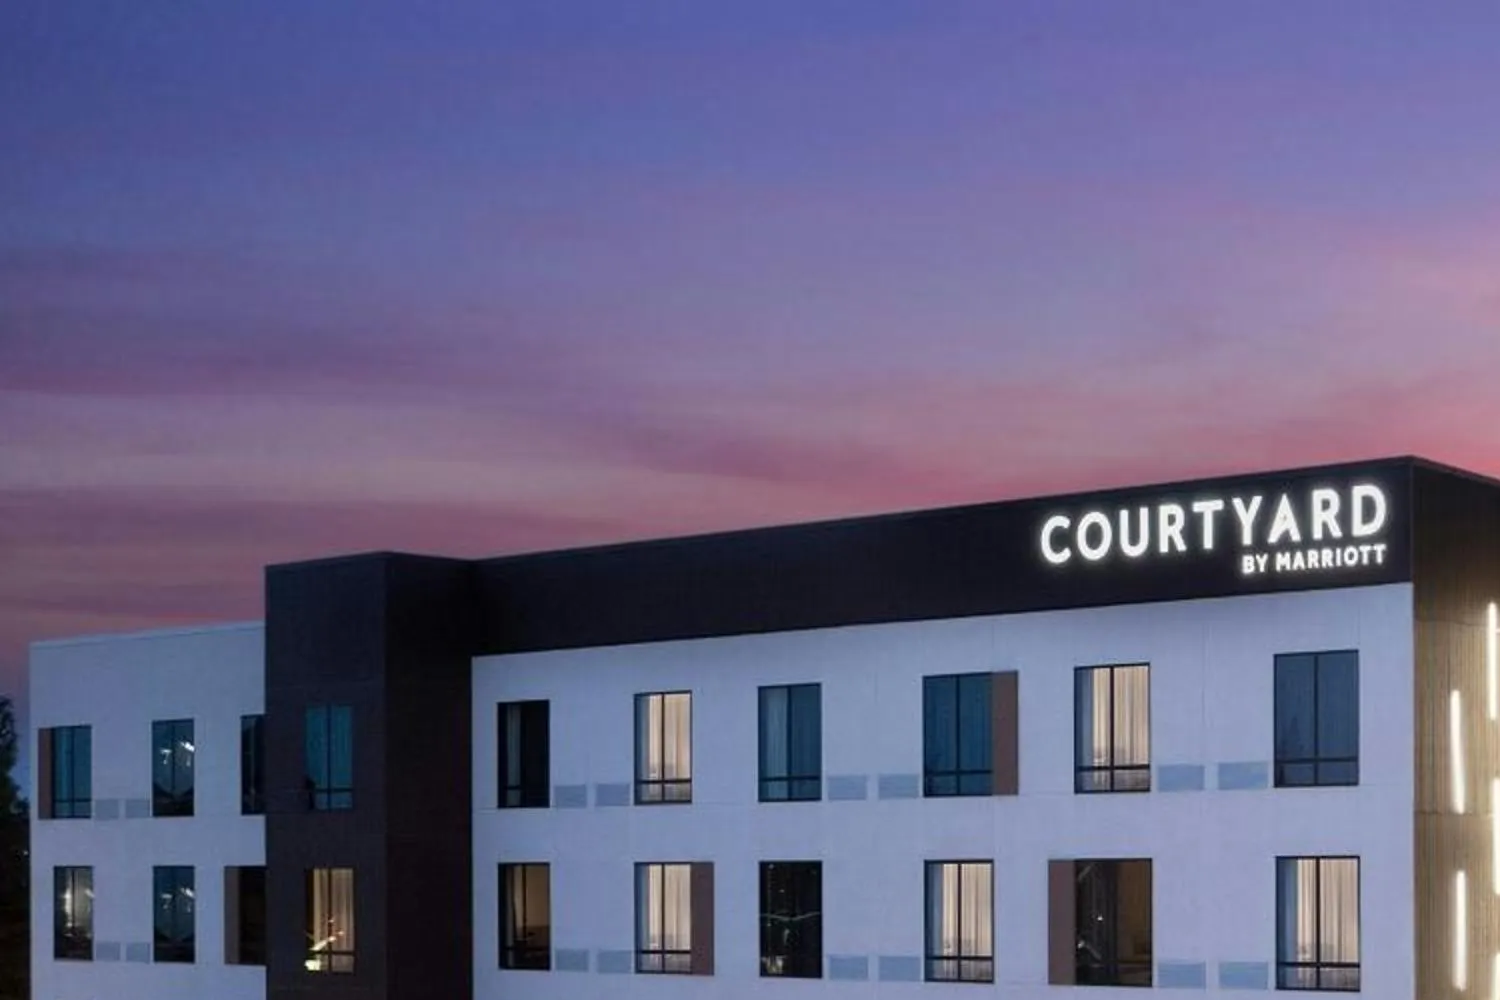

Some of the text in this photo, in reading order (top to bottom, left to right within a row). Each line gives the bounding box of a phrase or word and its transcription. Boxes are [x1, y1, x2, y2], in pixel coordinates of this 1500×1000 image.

[1040, 484, 1387, 565] COURTYARD
[1241, 543, 1387, 575] BY MARRIOTT
